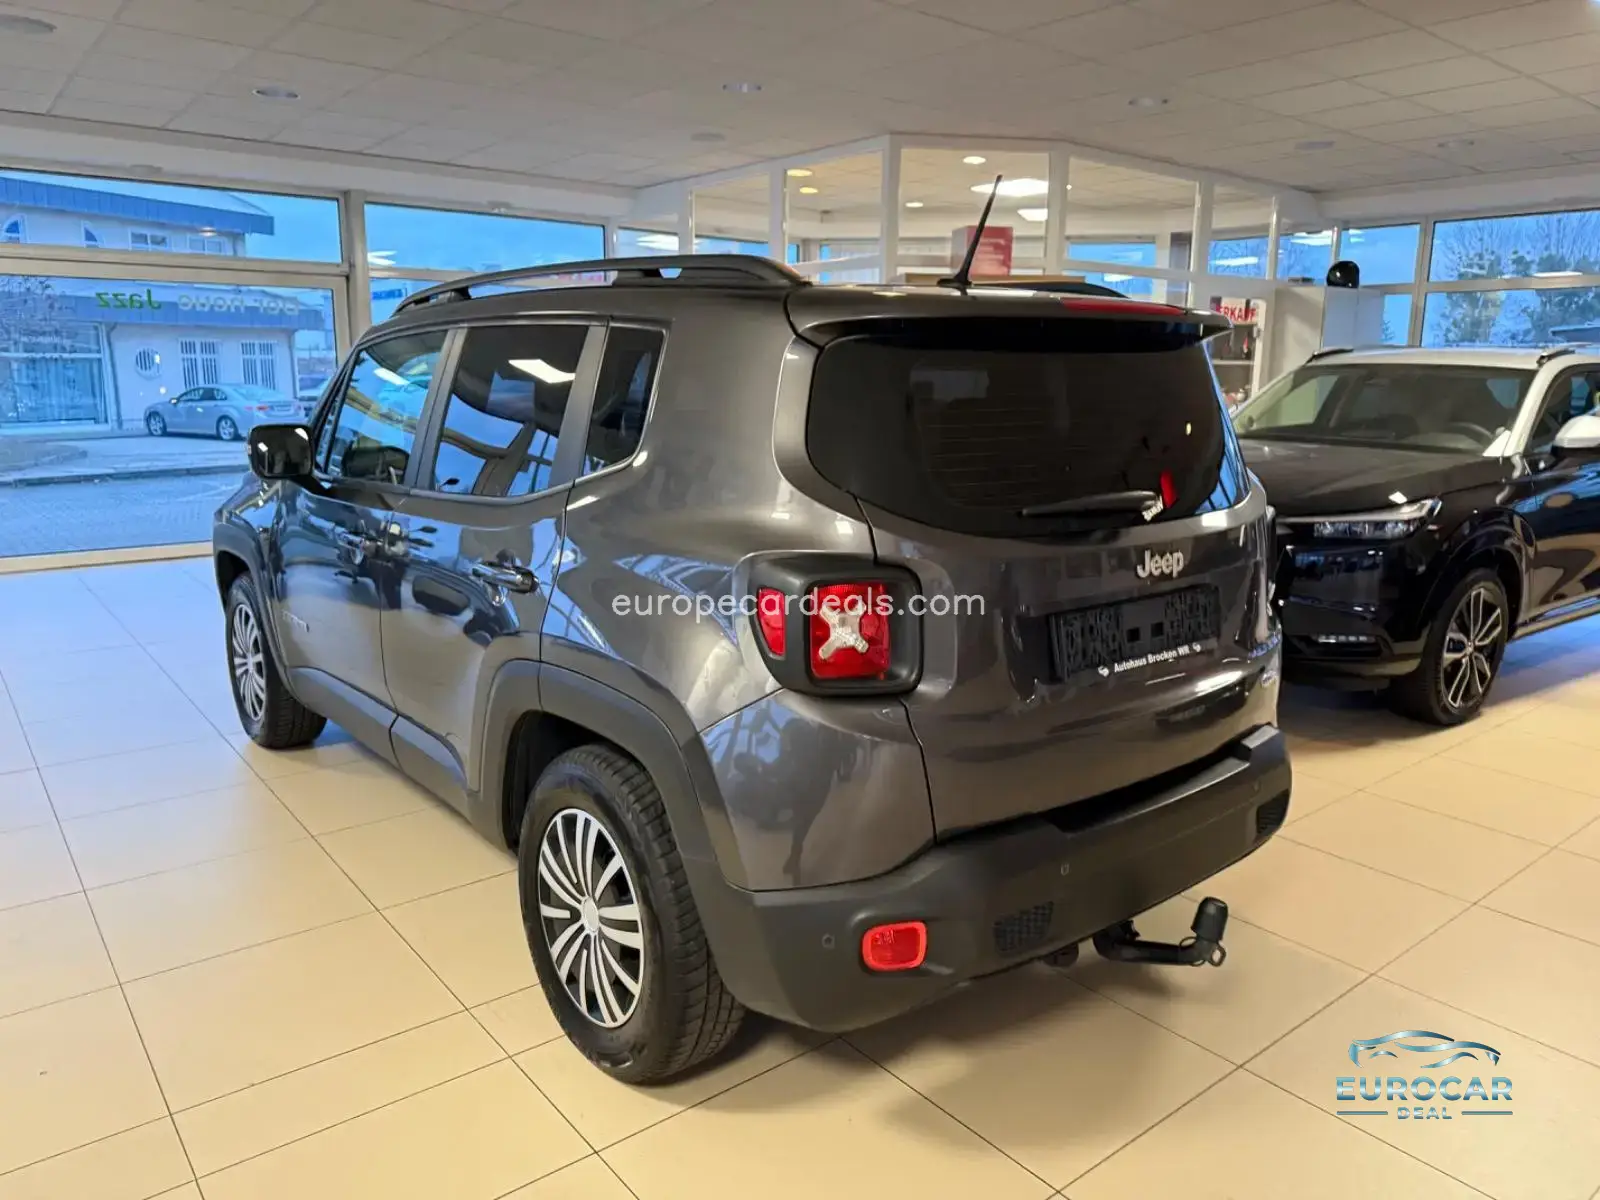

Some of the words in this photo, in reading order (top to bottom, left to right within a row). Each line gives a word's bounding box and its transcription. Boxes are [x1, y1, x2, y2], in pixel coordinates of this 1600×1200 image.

[1136, 549, 1184, 579] Jeep
[1114, 658, 1147, 673] Autohaus
[1147, 650, 1178, 664] Brocken
